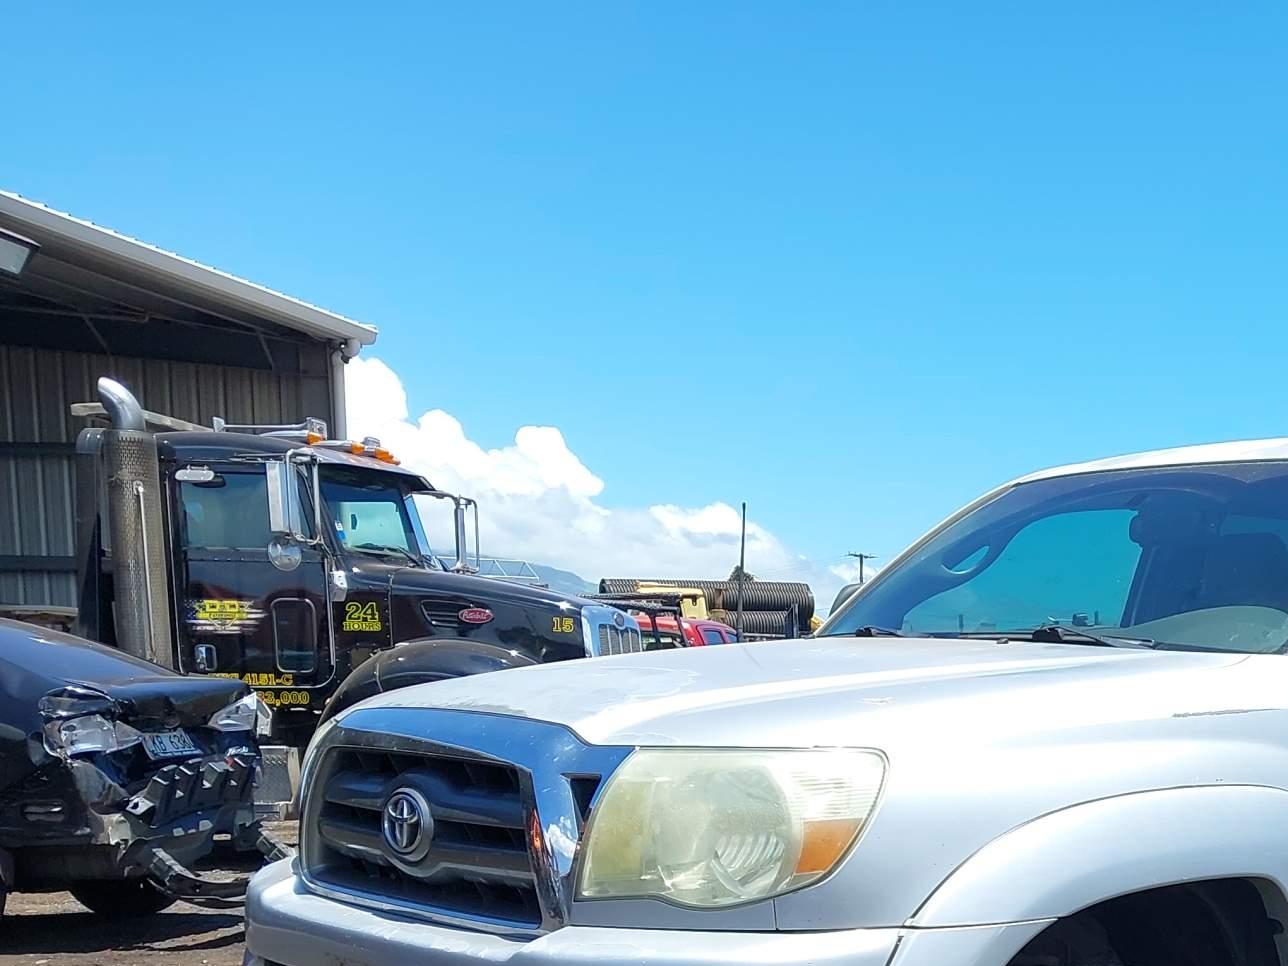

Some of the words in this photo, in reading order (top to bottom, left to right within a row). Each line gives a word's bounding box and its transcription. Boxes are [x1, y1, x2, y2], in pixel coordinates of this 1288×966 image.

[345, 601, 379, 622] 24
[343, 621, 382, 632] HOURS
[552, 617, 574, 632] 15
